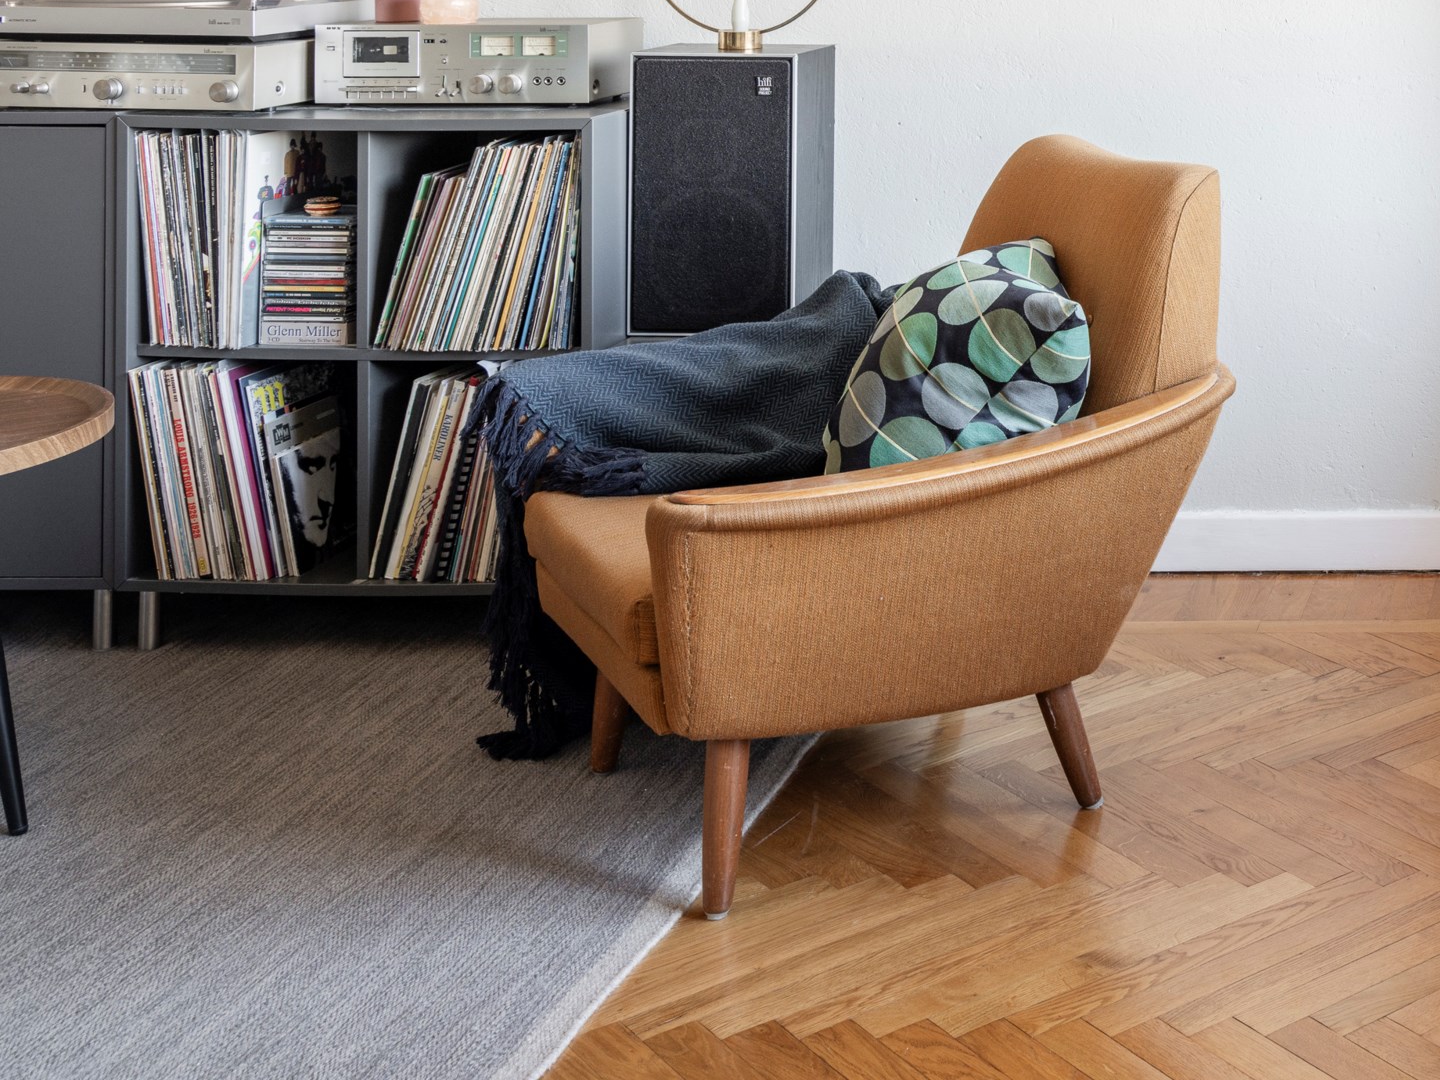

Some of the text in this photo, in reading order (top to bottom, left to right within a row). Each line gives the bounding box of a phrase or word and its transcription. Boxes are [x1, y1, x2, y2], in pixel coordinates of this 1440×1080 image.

[757, 77, 772, 86] hifi
[267, 326, 341, 336] Glenn Miller
[173, 419, 184, 443] LOUIS
[434, 414, 454, 461] KAROLINER
[176, 447, 194, 498] ARMSTRONG
